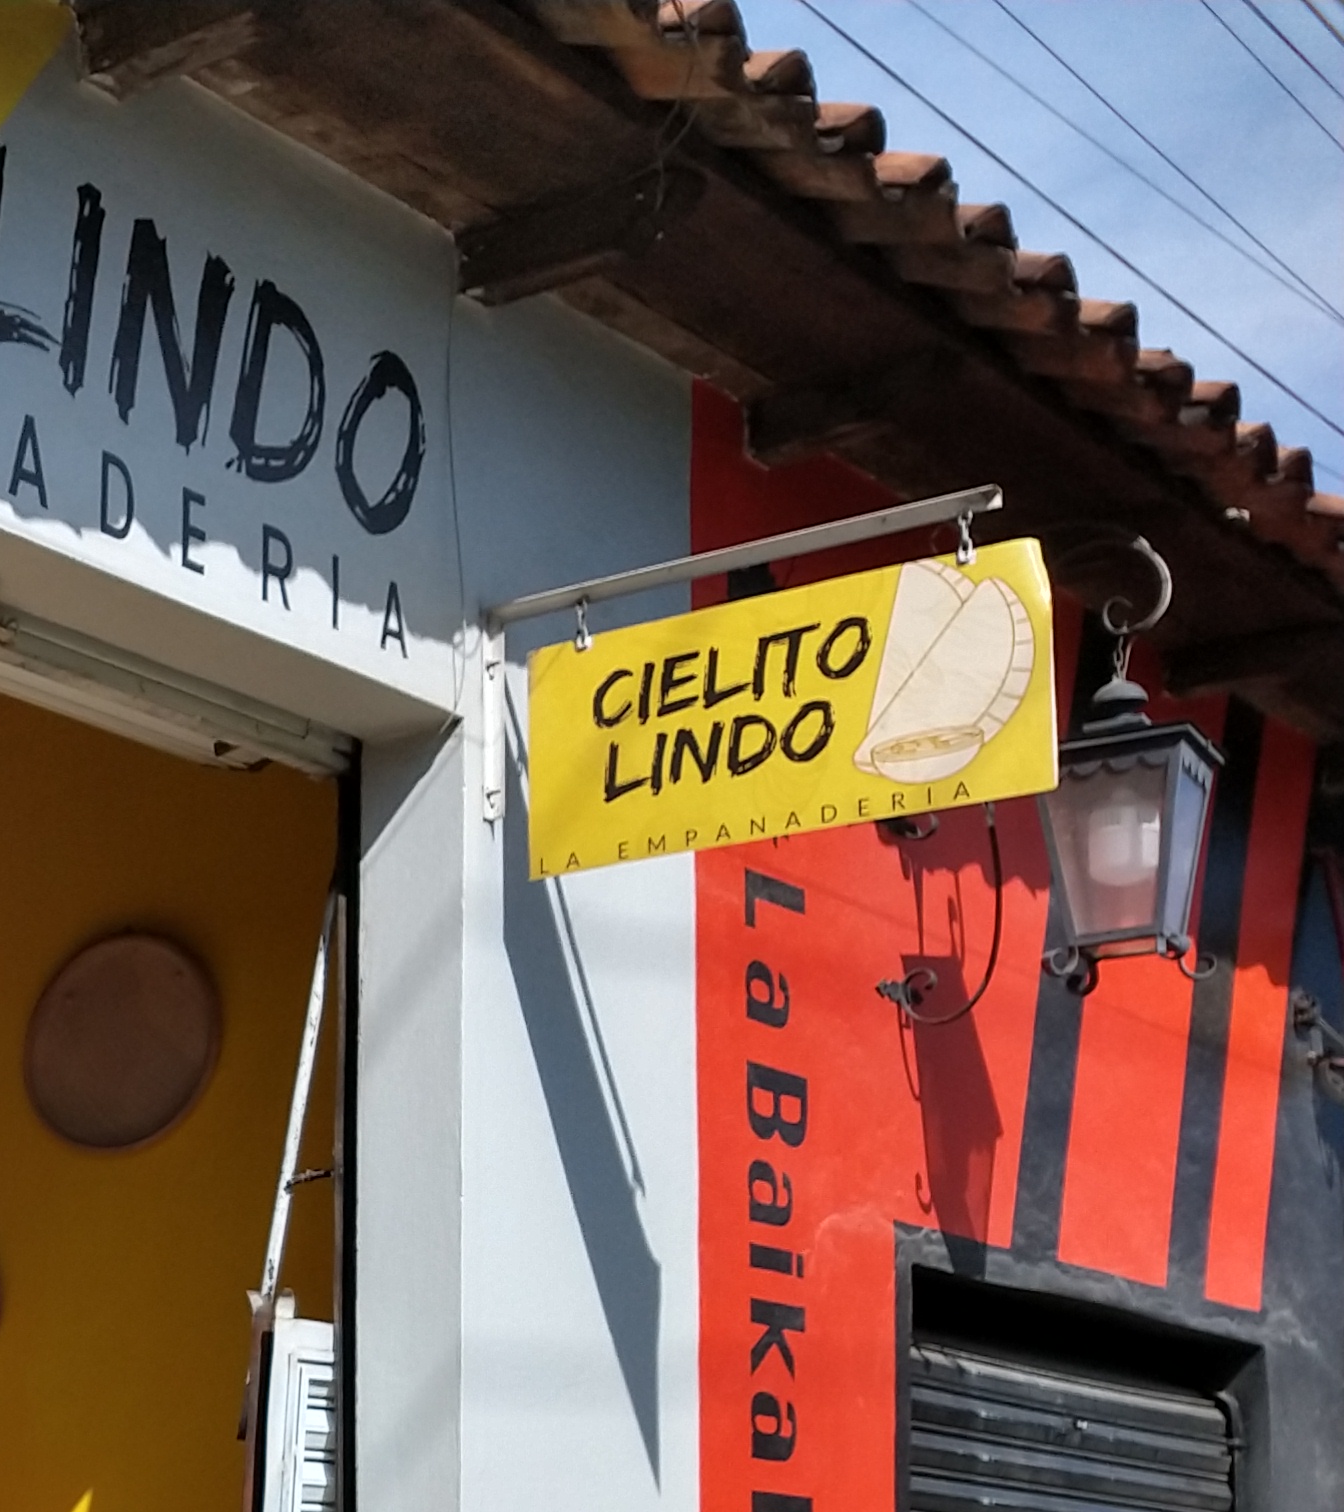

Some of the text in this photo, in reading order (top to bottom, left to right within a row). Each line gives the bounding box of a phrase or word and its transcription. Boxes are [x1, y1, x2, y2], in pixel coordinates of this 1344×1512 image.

[593, 616, 872, 729] CIELITO
[603, 700, 836, 803] LINDO
[539, 781, 971, 875] LA EMPANADERIA
